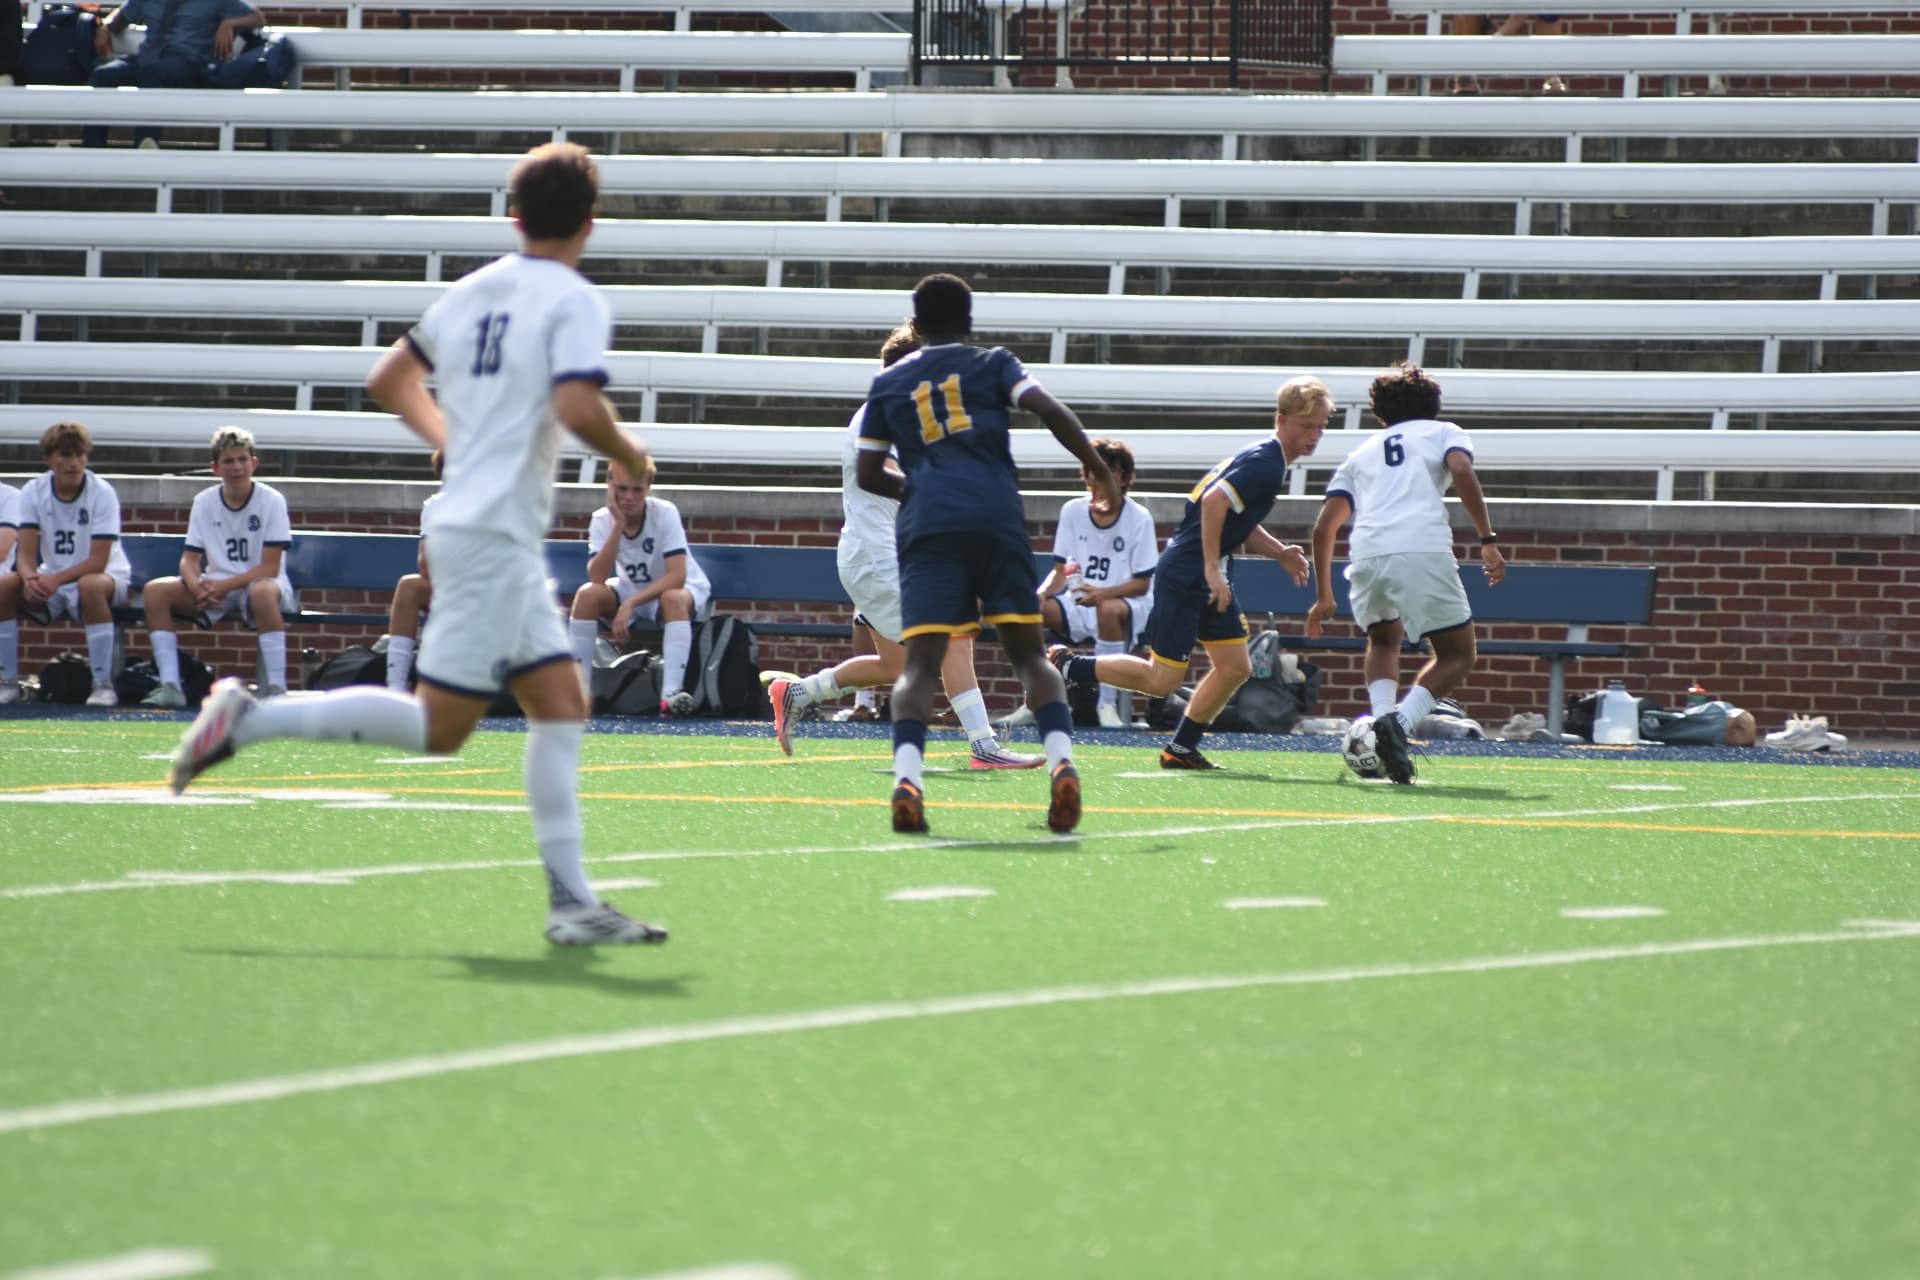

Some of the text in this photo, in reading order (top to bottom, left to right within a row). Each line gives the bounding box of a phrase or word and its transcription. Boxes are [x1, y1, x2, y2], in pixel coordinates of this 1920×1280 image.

[911, 374, 973, 446] 11
[1384, 433, 1405, 467] 6
[54, 530, 76, 555] 25
[226, 537, 249, 563] 20
[625, 562, 652, 584] 23
[1085, 555, 1111, 581] 29
